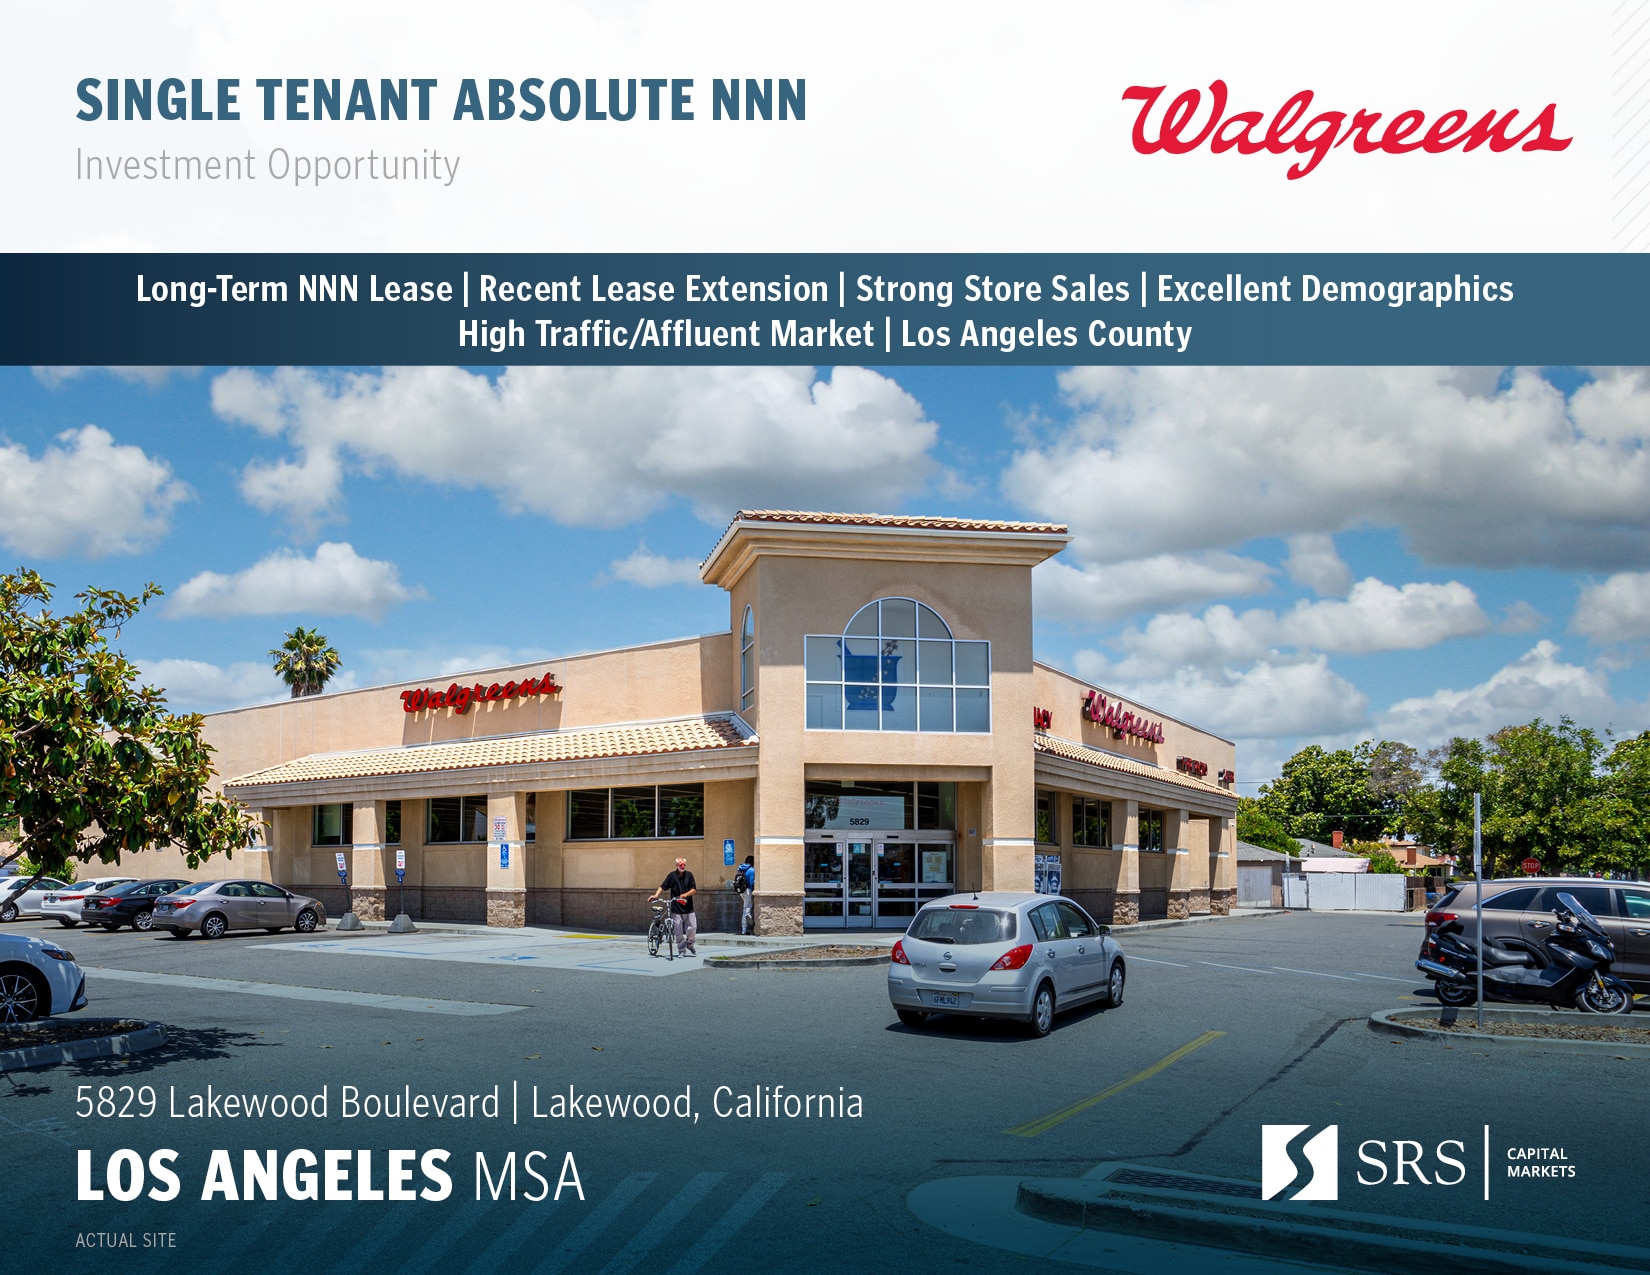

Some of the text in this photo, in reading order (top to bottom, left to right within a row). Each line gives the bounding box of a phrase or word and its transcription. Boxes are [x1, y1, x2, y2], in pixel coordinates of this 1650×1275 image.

[400, 672, 559, 714] Walgreens
[1084, 690, 1165, 744] Walgreens
[849, 818, 870, 826] 5829
